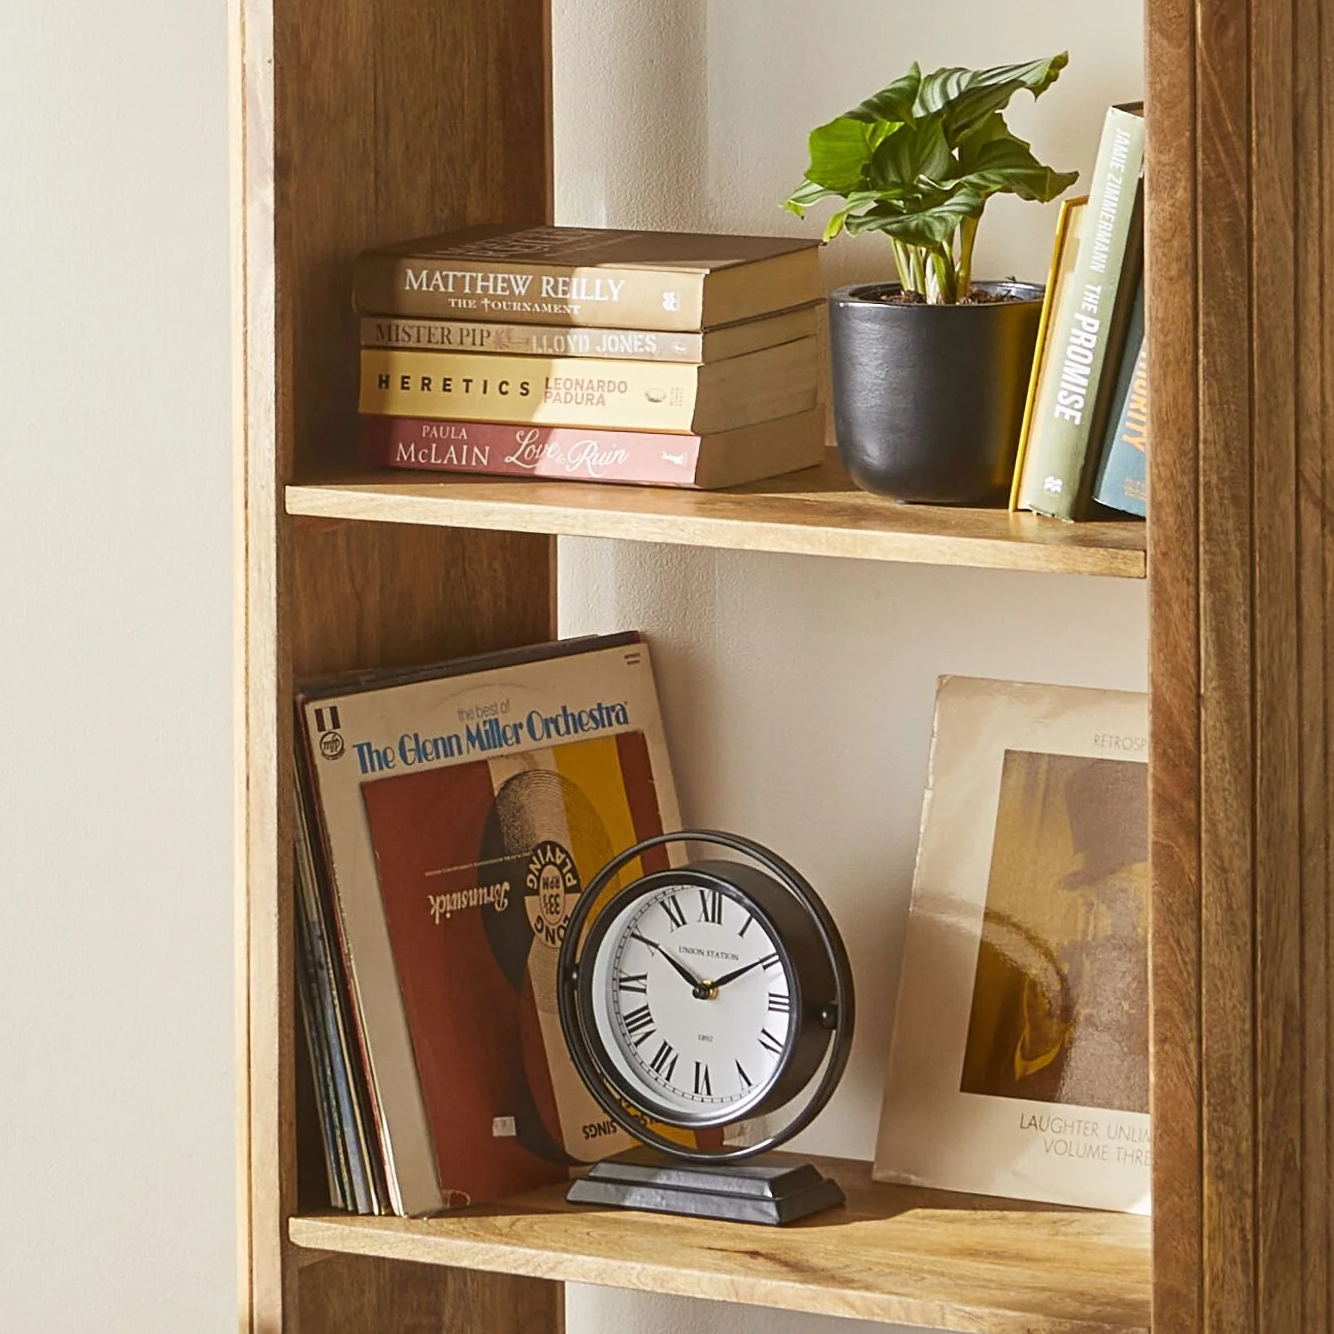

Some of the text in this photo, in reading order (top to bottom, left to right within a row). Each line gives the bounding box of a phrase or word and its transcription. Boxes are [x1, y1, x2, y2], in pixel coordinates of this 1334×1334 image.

[1090, 128, 1132, 274] JAMIE ZIMMERMANN
[404, 269, 627, 302] MATTHEW REILLY
[448, 298, 478, 309] THE
[375, 323, 492, 347] MISTER PIP
[531, 333, 658, 355] LLOYD JONES
[1054, 283, 1101, 426] THE PROMISE
[378, 373, 531, 397] HERETICS
[545, 376, 628, 394] LEONARDO
[543, 390, 606, 407] PADURA
[422, 425, 468, 440] PAULA
[395, 442, 490, 467] McLAIN
[505, 428, 559, 469] Love
[565, 439, 629, 478] Ruin
[457, 699, 511, 722] the best of
[351, 702, 629, 775] The Glenn Miller Orchestra
[526, 844, 578, 890] PLAYING
[542, 875, 561, 889] RPM
[427, 880, 511, 926] Brunswick
[698, 889, 722, 926] XII
[678, 945, 740, 961] UNION STATION
[1019, 1112, 1099, 1138] LAUGHTER
[1043, 1138, 1108, 1162] VOLUME
